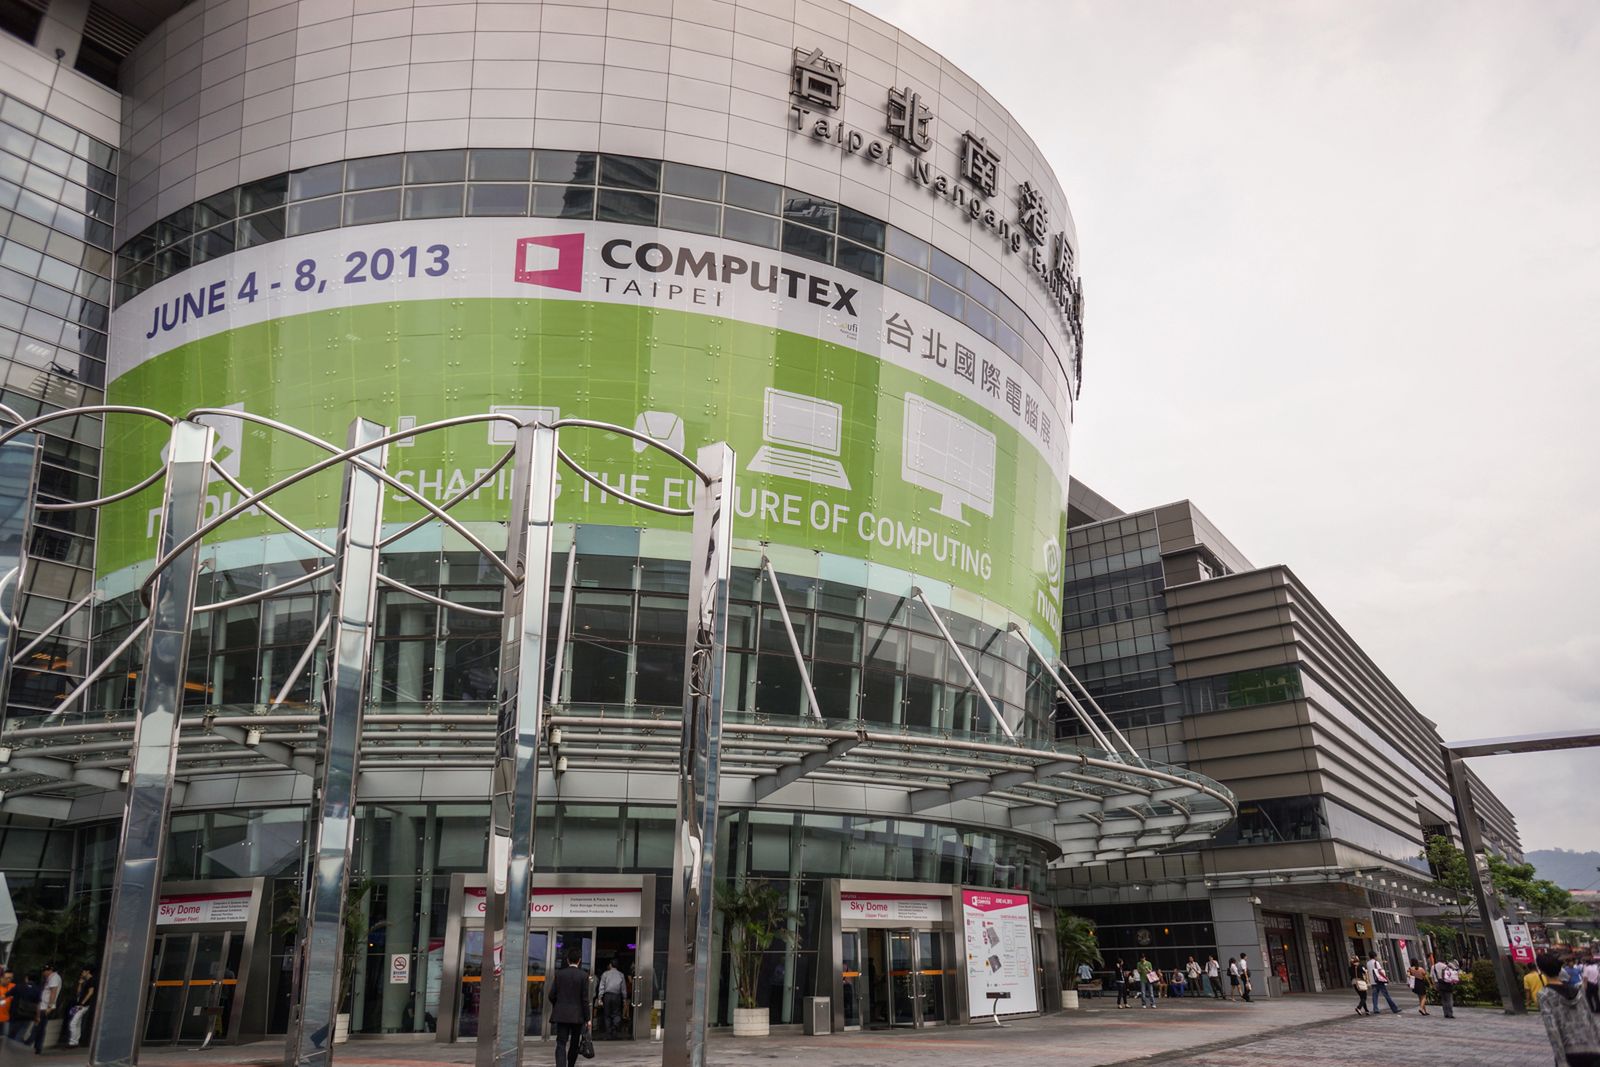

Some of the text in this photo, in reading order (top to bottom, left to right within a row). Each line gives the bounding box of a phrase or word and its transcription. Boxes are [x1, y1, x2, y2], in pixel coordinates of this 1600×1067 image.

[791, 104, 894, 165] Taipei
[912, 157, 1021, 253] Nangang
[146, 244, 450, 339] JUNE 4 - 8, 2013
[600, 276, 721, 307] TAIPEI
[601, 239, 858, 317] COMPUTEX
[885, 312, 1051, 450] 台北國際電腦展
[392, 468, 992, 580] SHAPI THE FUURE OF COMPUTING
[160, 905, 176, 917] Sky
[177, 904, 201, 914] Dome
[530, 902, 554, 912] loor
[850, 901, 864, 912] Sky
[866, 902, 888, 911] Dome
